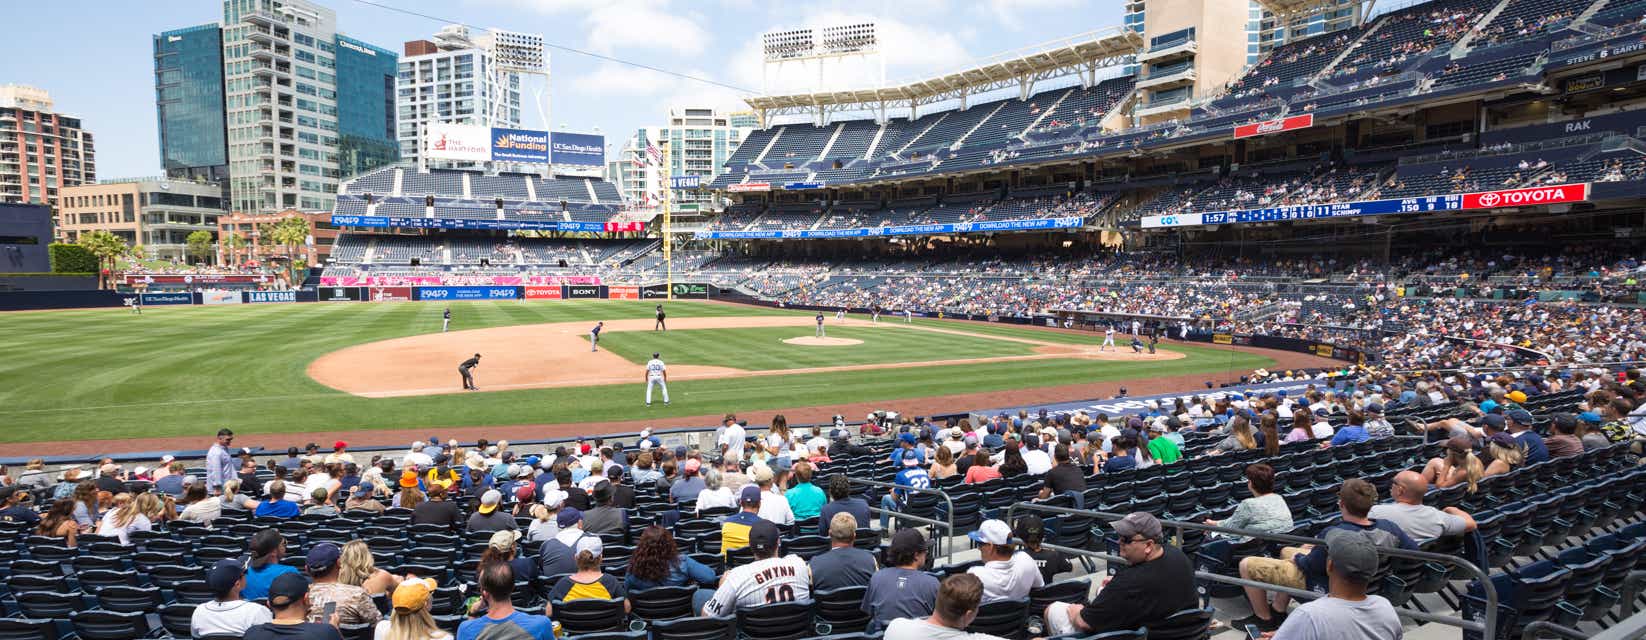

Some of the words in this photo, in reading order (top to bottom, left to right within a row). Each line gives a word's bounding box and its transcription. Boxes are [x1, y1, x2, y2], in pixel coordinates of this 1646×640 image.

[1567, 54, 1596, 65] STEVE
[1566, 120, 1592, 132] RAK
[510, 134, 546, 142] National
[510, 142, 547, 151] Funding
[1502, 189, 1565, 204] TOYOTA
[1205, 214, 1225, 223] 1:57
[251, 292, 266, 302] LAS
[268, 292, 295, 302] VEGAS
[755, 566, 795, 584] GWYNN
